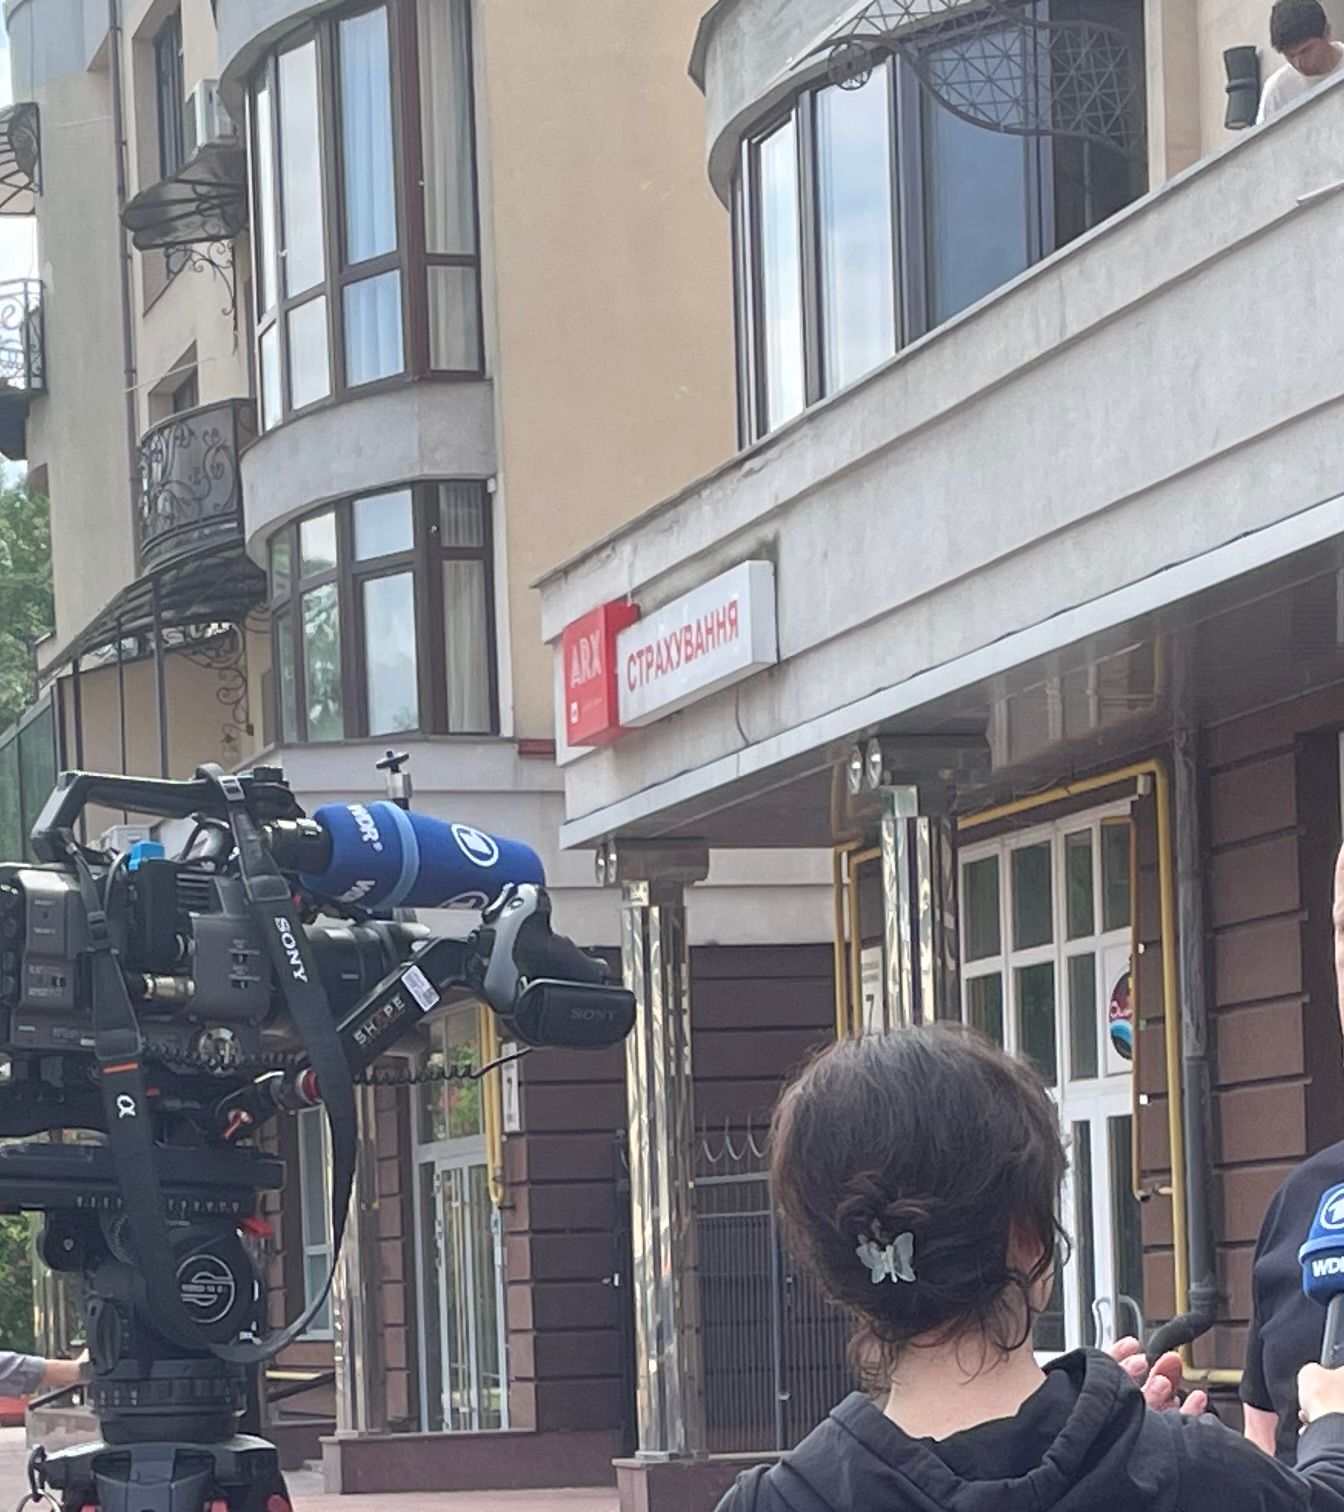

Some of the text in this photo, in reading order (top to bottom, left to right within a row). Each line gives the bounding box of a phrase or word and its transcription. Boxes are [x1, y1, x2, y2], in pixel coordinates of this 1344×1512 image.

[569, 630, 603, 690] ARX
[625, 599, 740, 693] СТРАХУВАННЯ
[274, 916, 309, 984] SONY
[351, 994, 407, 1046] SHAPE
[569, 1006, 617, 1022] SONY
